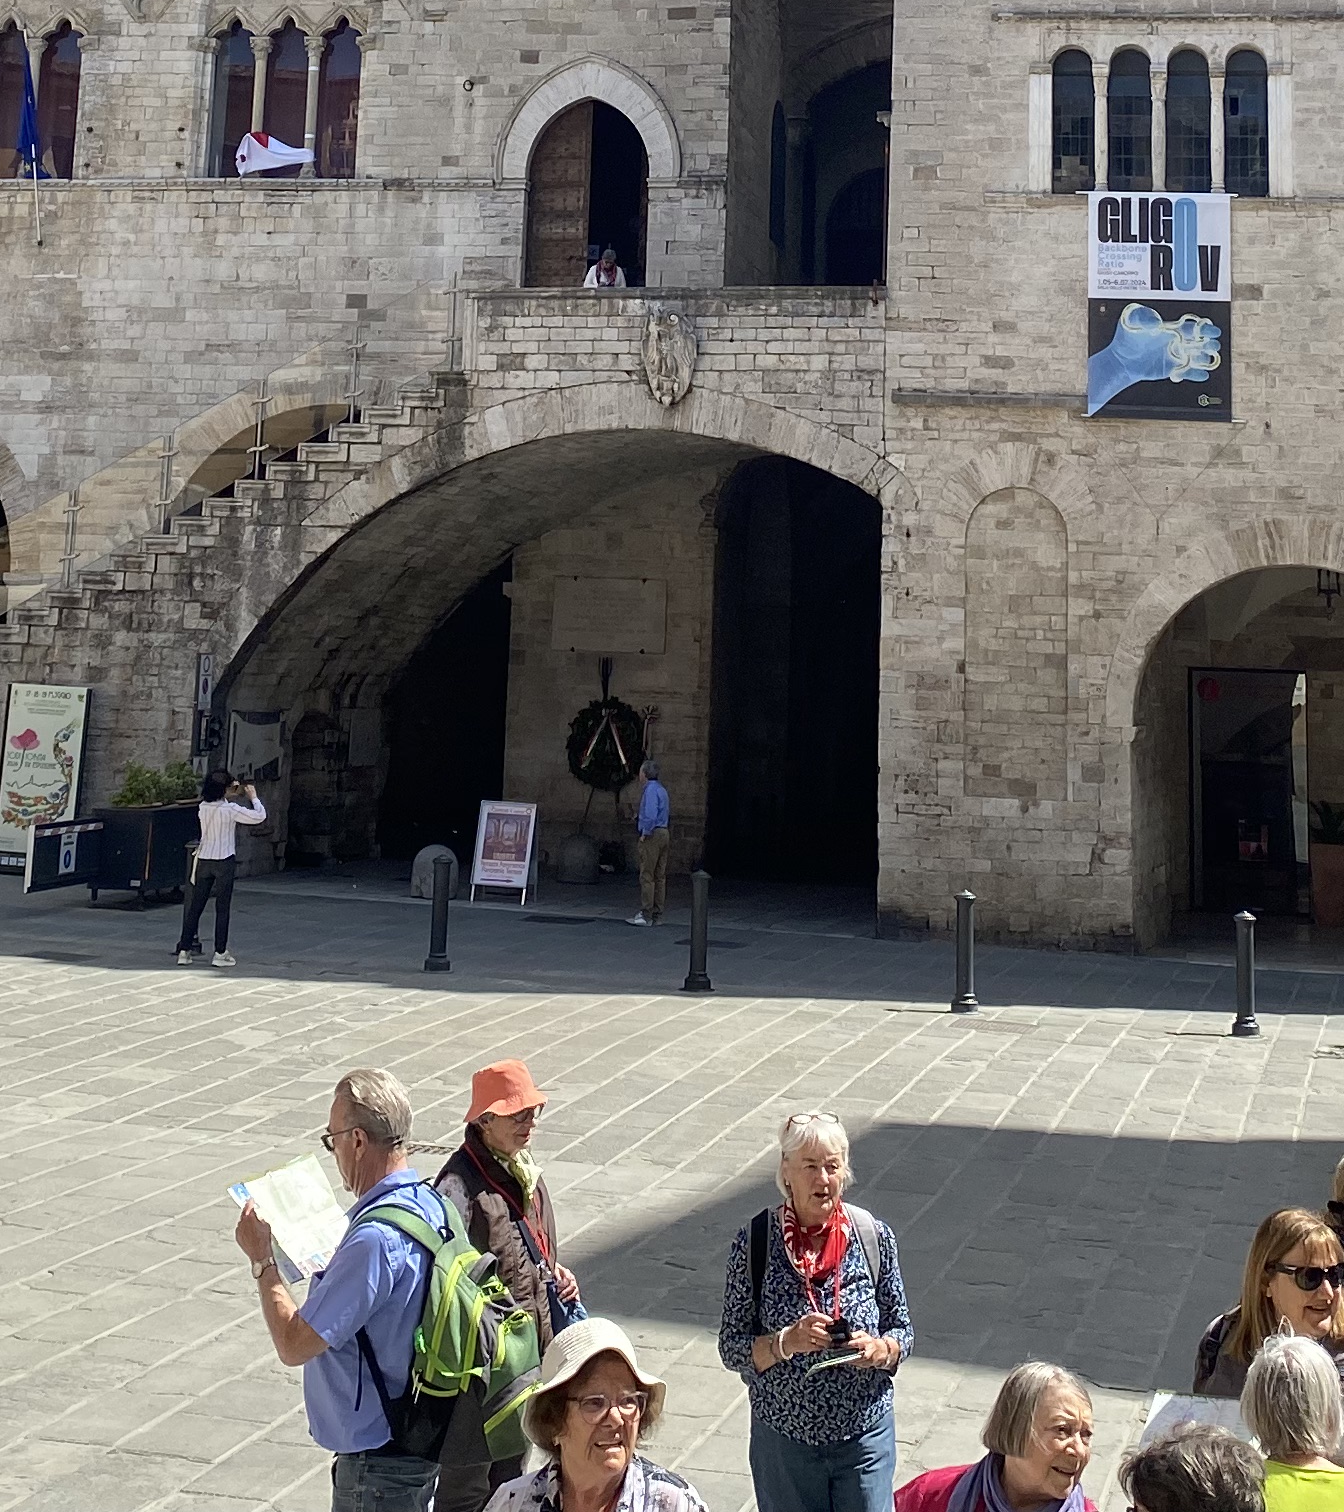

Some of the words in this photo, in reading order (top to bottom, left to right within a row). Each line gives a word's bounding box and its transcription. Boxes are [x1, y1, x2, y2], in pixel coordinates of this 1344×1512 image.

[1098, 244, 1148, 253] Backbone
[1098, 252, 1143, 262] Crossing
[1098, 260, 1125, 268] Ratio
